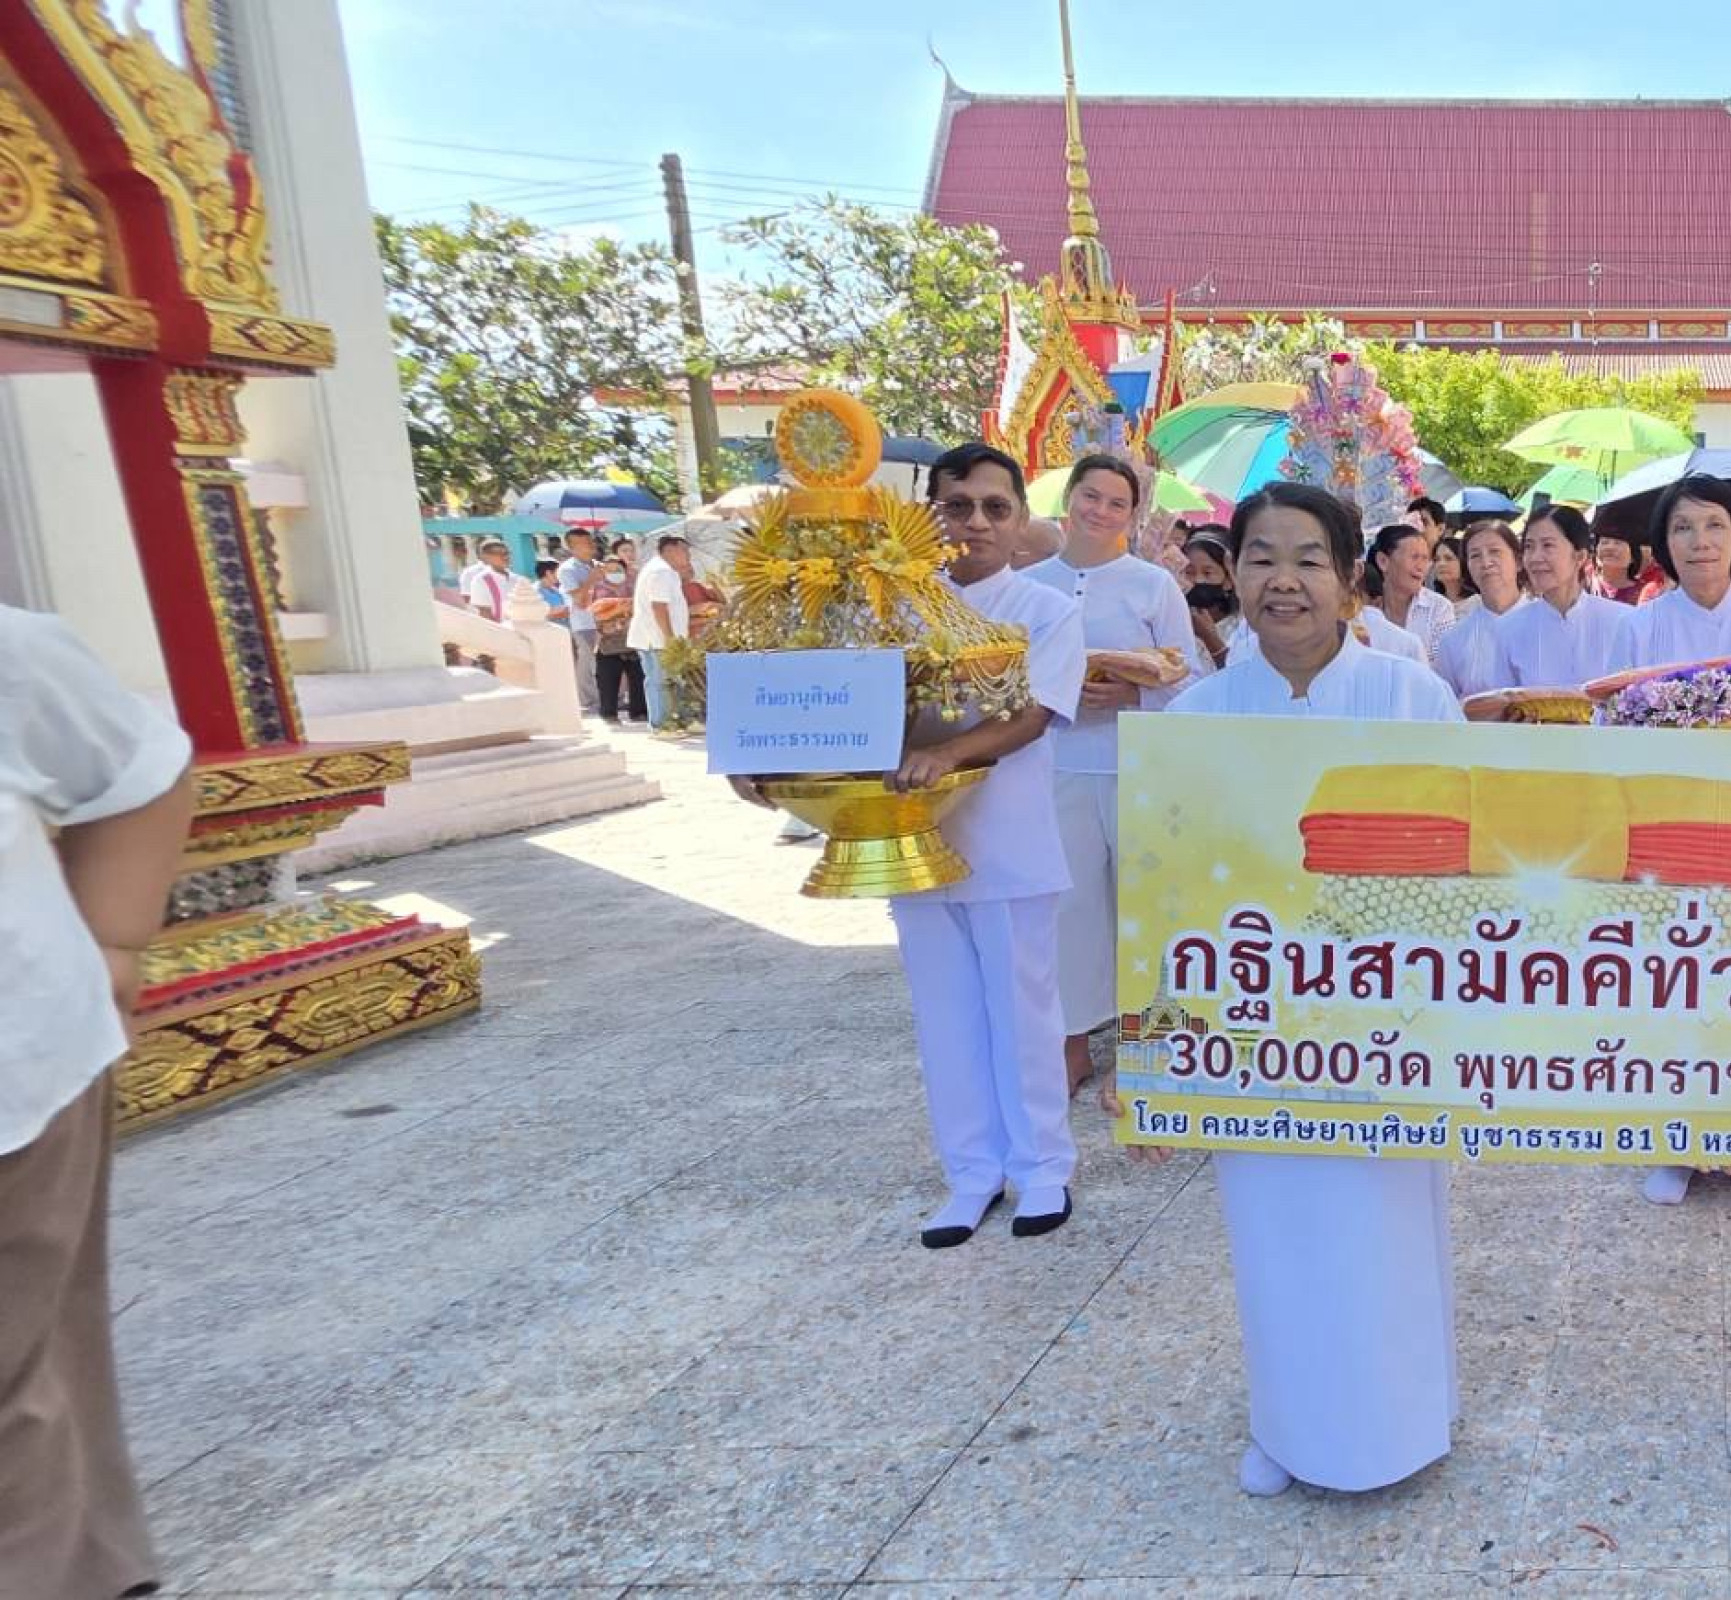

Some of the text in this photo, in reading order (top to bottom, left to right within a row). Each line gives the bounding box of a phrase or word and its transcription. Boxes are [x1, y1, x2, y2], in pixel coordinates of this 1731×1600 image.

[737, 728, 868, 749] วัดพระธรรมกาย
[1169, 1030, 1431, 1089] 30,000วัด
[1134, 1101, 1188, 1134] โดย
[1202, 1110, 1447, 1152] คณะศิษยานุศิษย์
[1461, 1126, 1602, 1157] บูชาธรรม
[1617, 1127, 1653, 1150] 81
[1666, 1121, 1688, 1151] ปี
